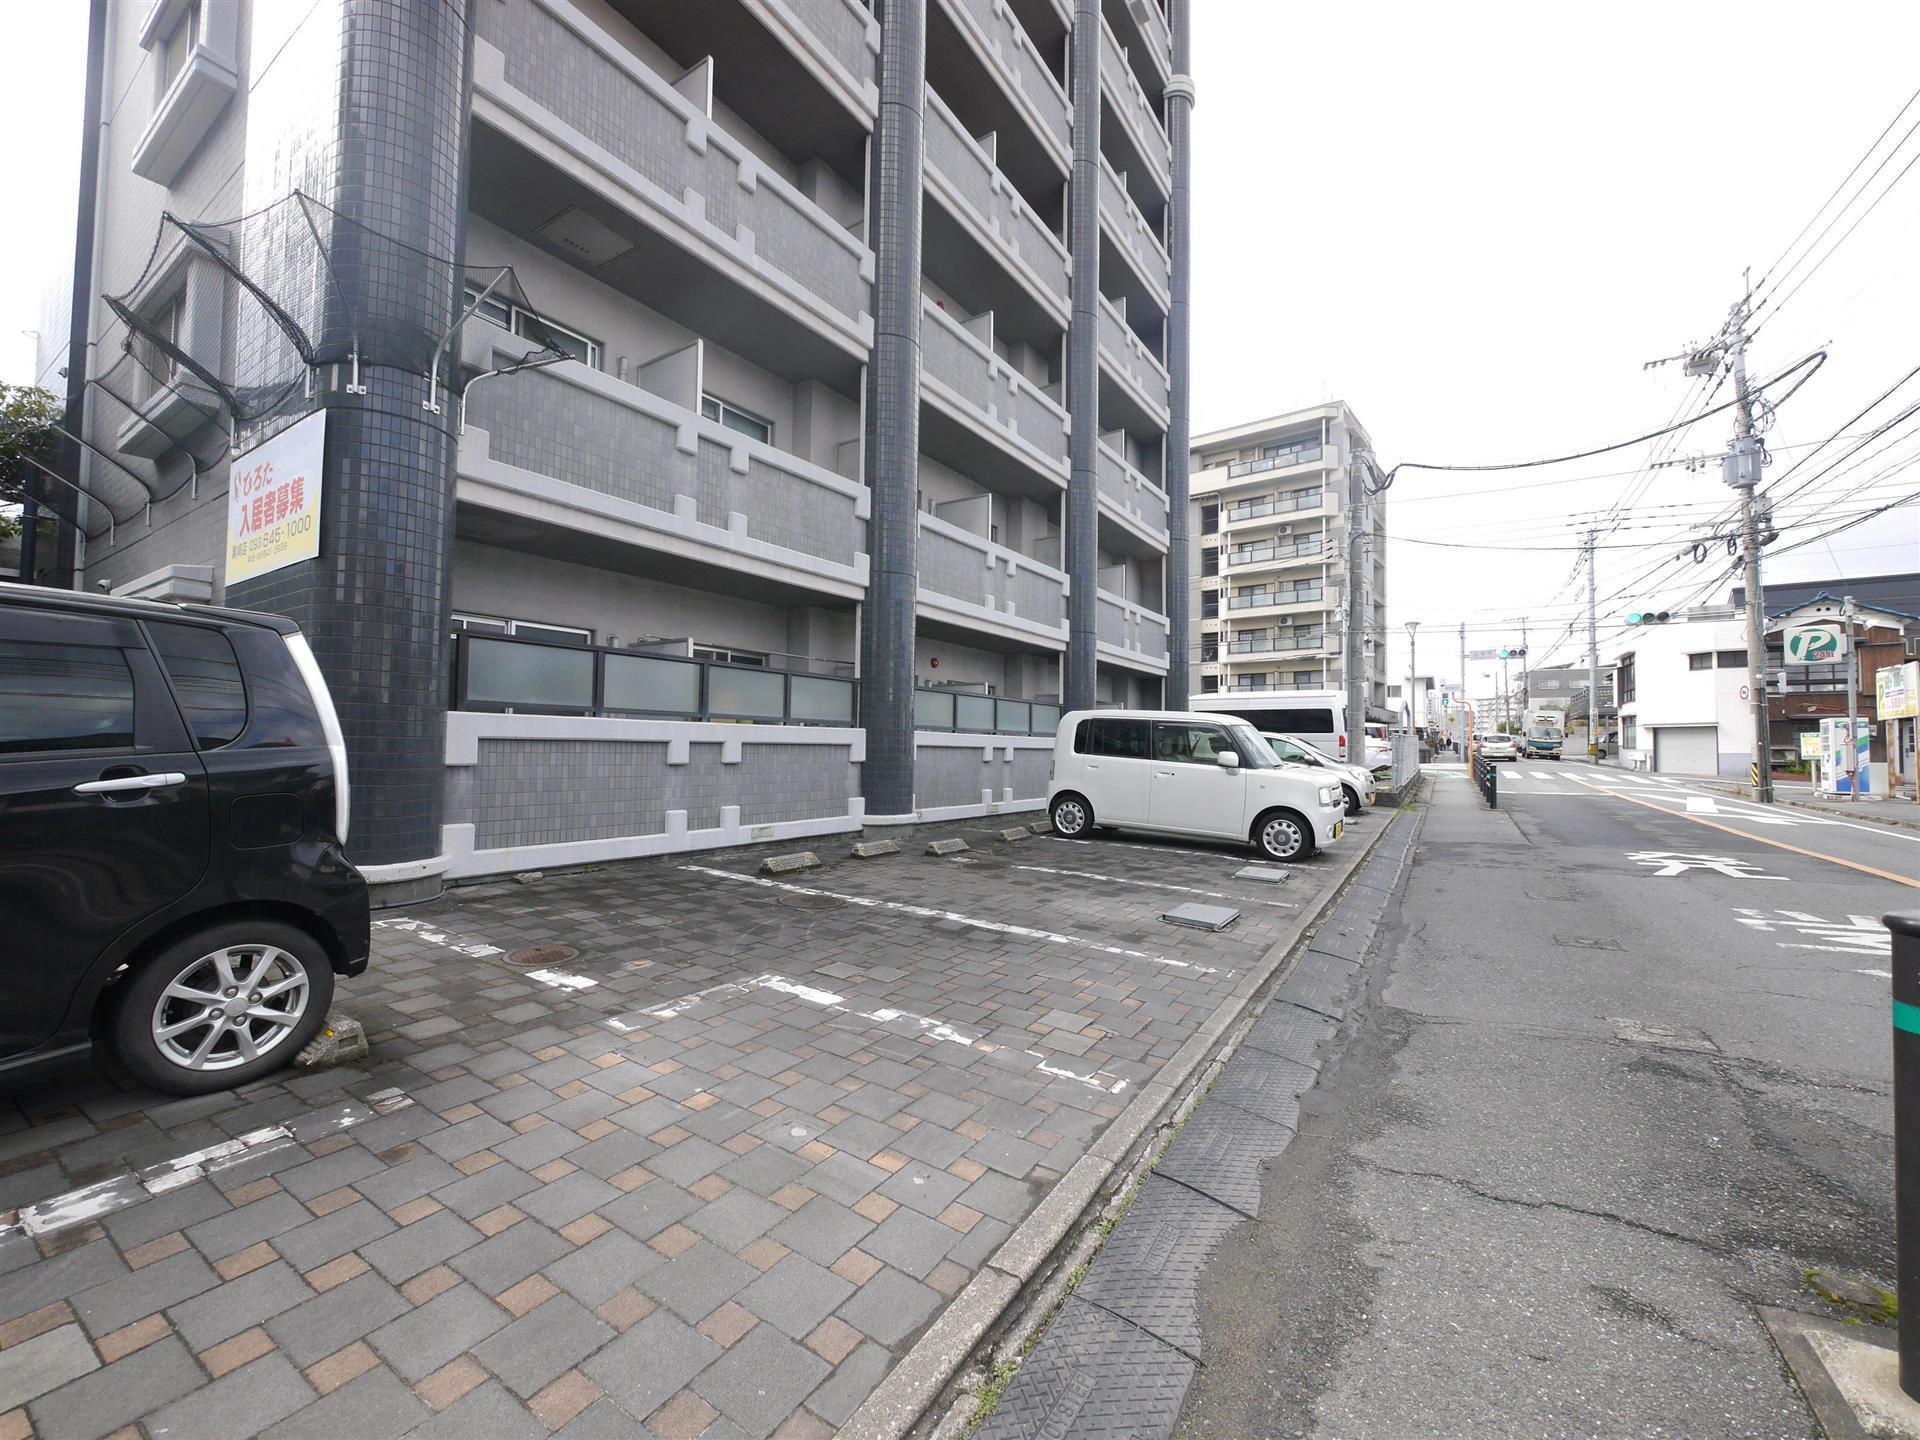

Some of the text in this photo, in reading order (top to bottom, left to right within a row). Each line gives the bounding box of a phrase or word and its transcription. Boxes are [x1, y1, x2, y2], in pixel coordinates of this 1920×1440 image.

[242, 460, 273, 497] ひろた
[239, 475, 305, 537] 入居者募集
